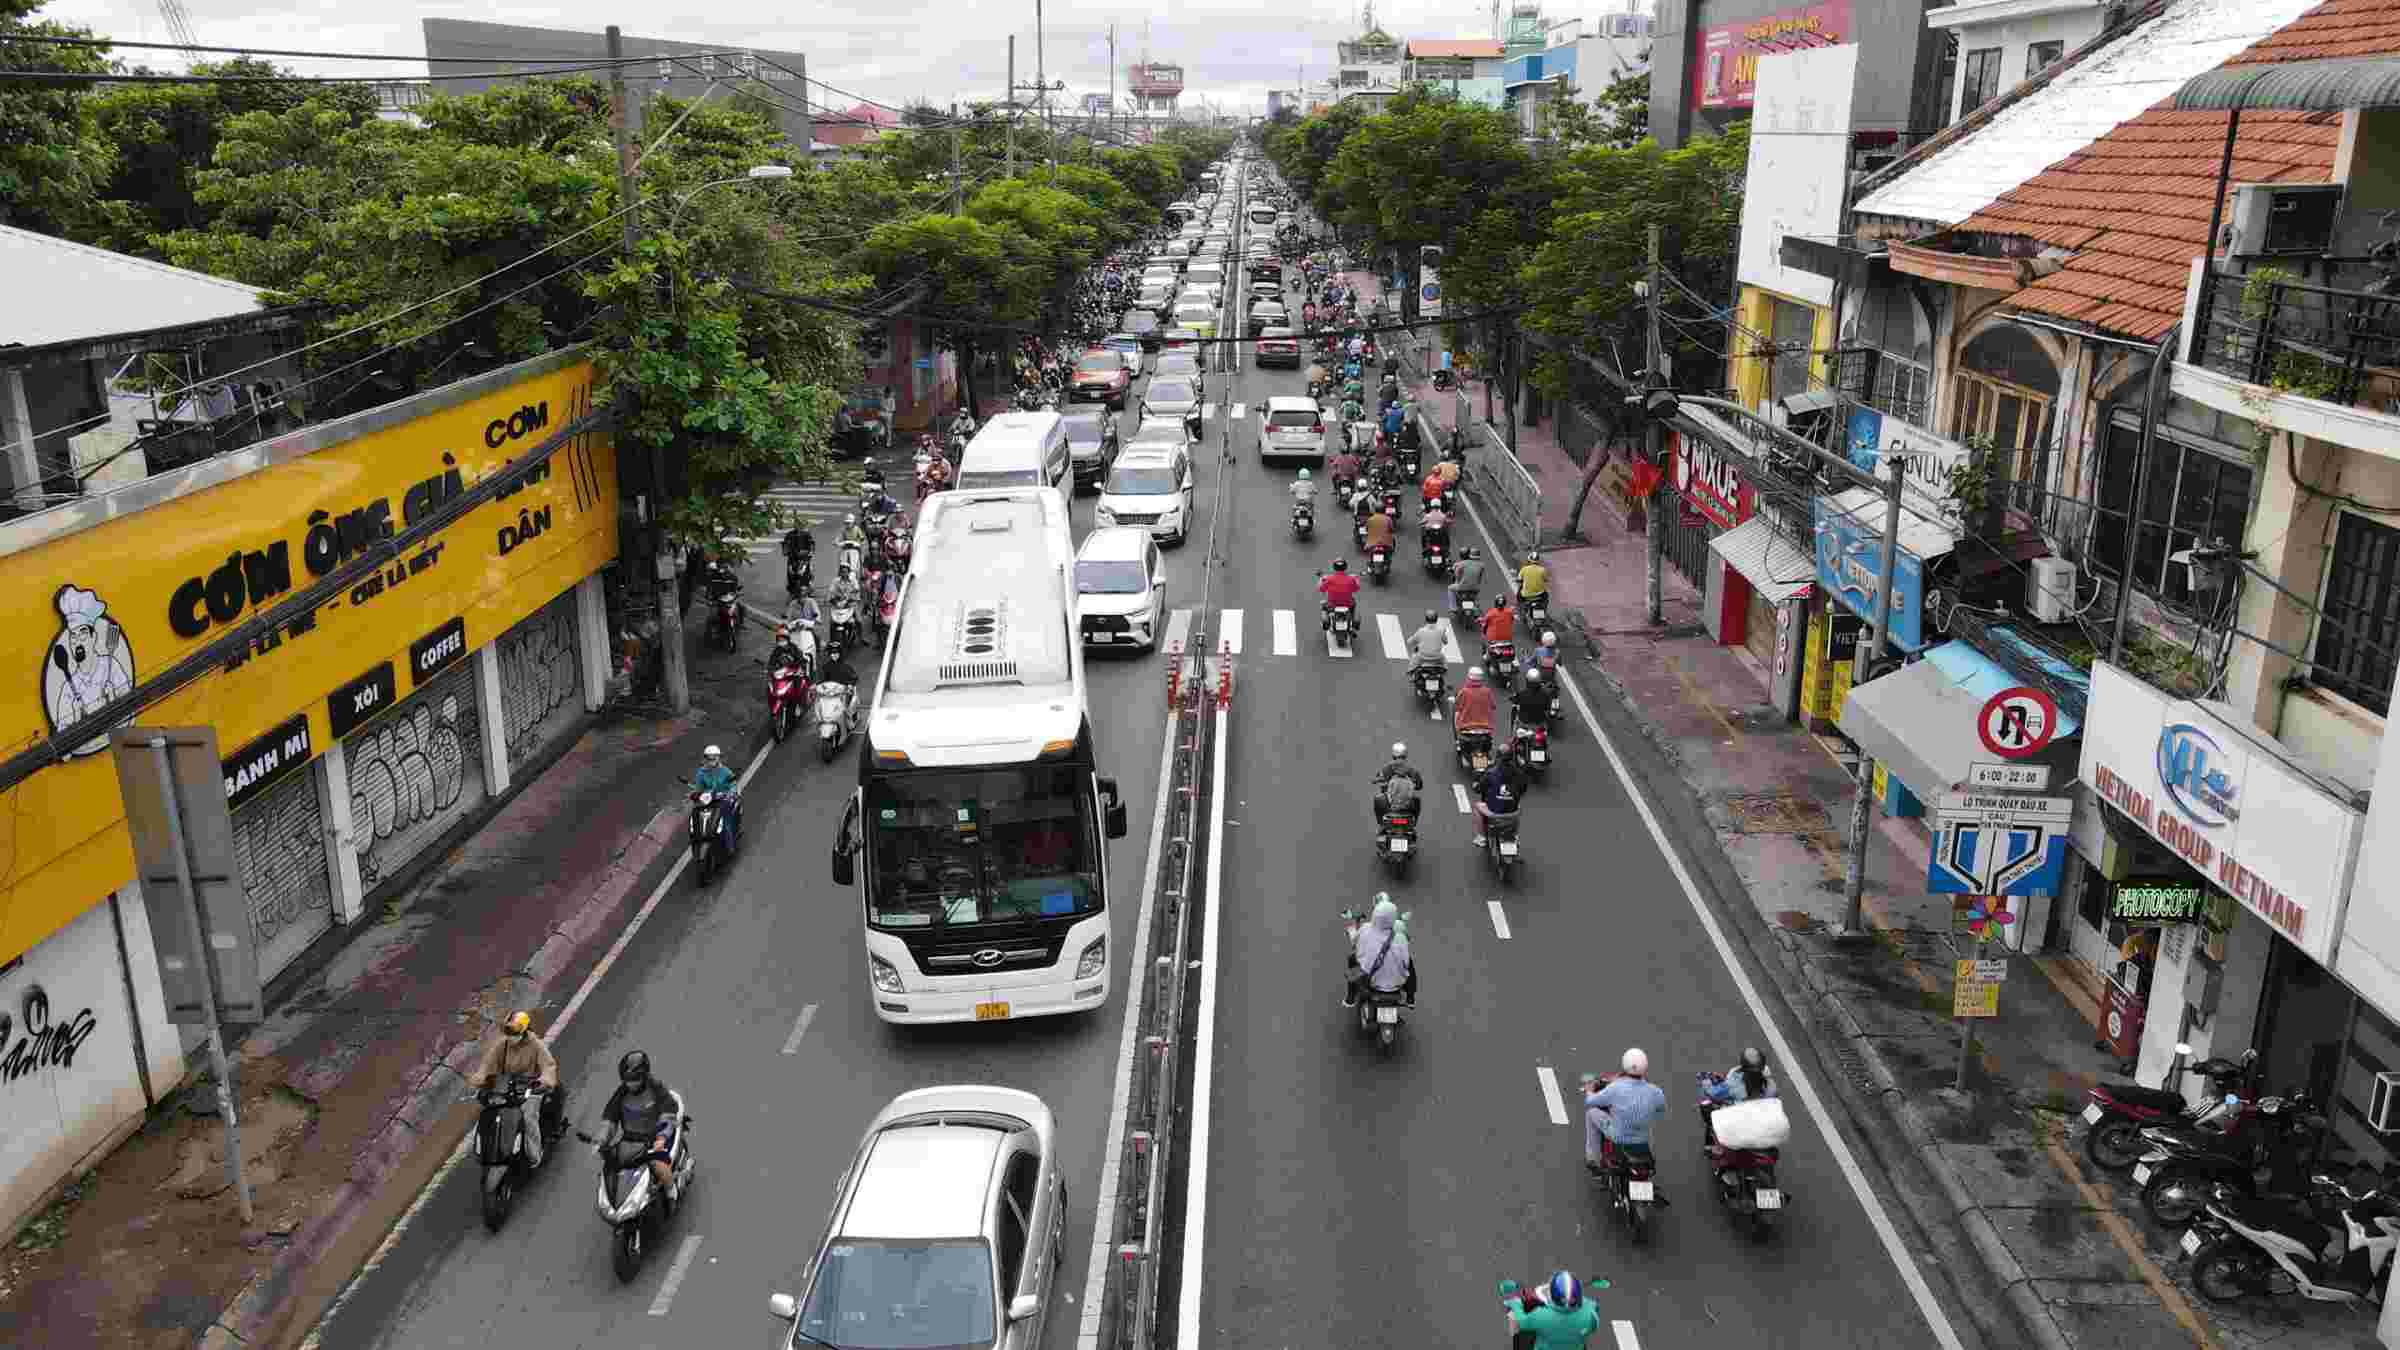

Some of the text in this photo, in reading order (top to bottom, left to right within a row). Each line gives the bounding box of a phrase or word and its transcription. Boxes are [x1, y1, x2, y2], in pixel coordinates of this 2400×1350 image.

[485, 400, 548, 449] CƠM
[498, 504, 552, 556] DÂN
[168, 539, 291, 639] CƠM
[304, 497, 394, 576] ÔNG
[420, 630, 460, 670] COFFEE
[2096, 761, 2152, 832] VIETHOA
[2158, 810, 2215, 870] GROUP
[2217, 849, 2305, 945] VIETNAM
[2113, 886, 2200, 918] PHOTOCOPY
